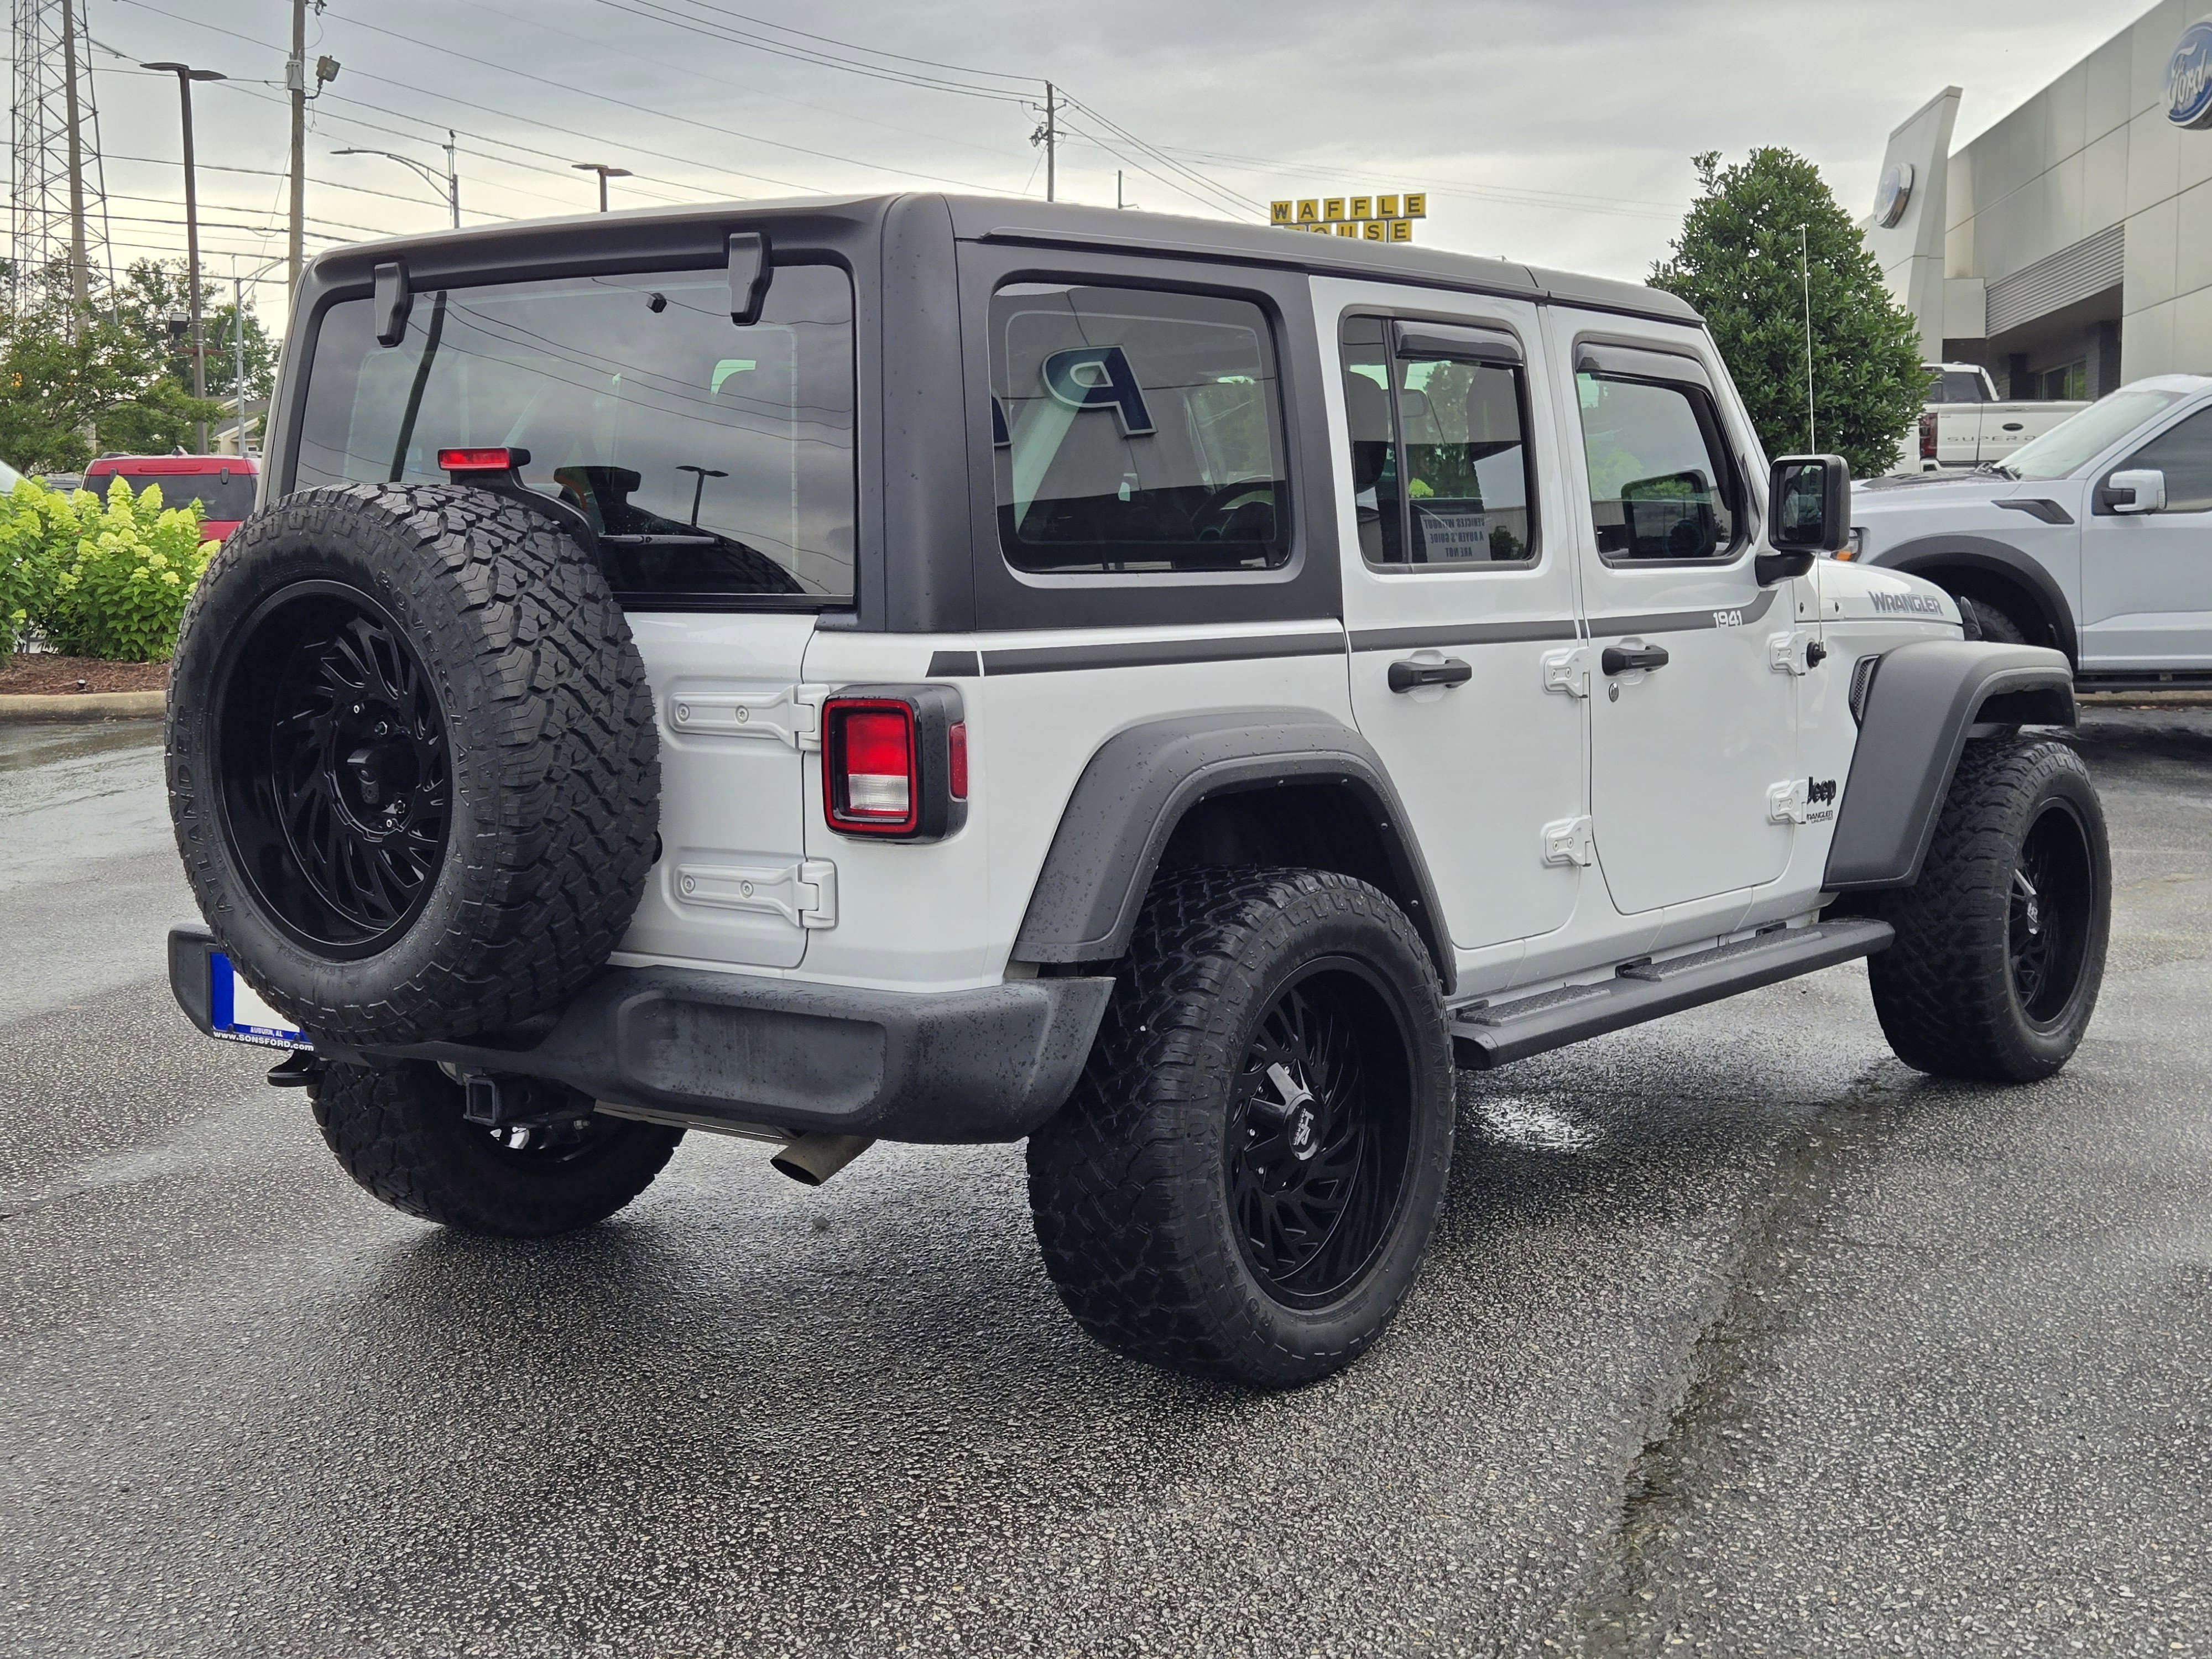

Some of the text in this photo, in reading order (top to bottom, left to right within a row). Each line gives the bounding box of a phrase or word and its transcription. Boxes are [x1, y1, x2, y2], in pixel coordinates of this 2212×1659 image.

[2167, 42, 2212, 112] Ford
[1273, 196, 1421, 220] WAFFLE
[1293, 223, 1407, 240] USE
[1866, 589, 1944, 616] WRANGLER
[1713, 610, 1743, 628] 1941
[1807, 776, 1837, 807] Jeep
[176, 705, 234, 914] ATLANDER
[213, 1031, 315, 1051] www.SONSFORD.com
[250, 1026, 275, 1037] AUBURN,
